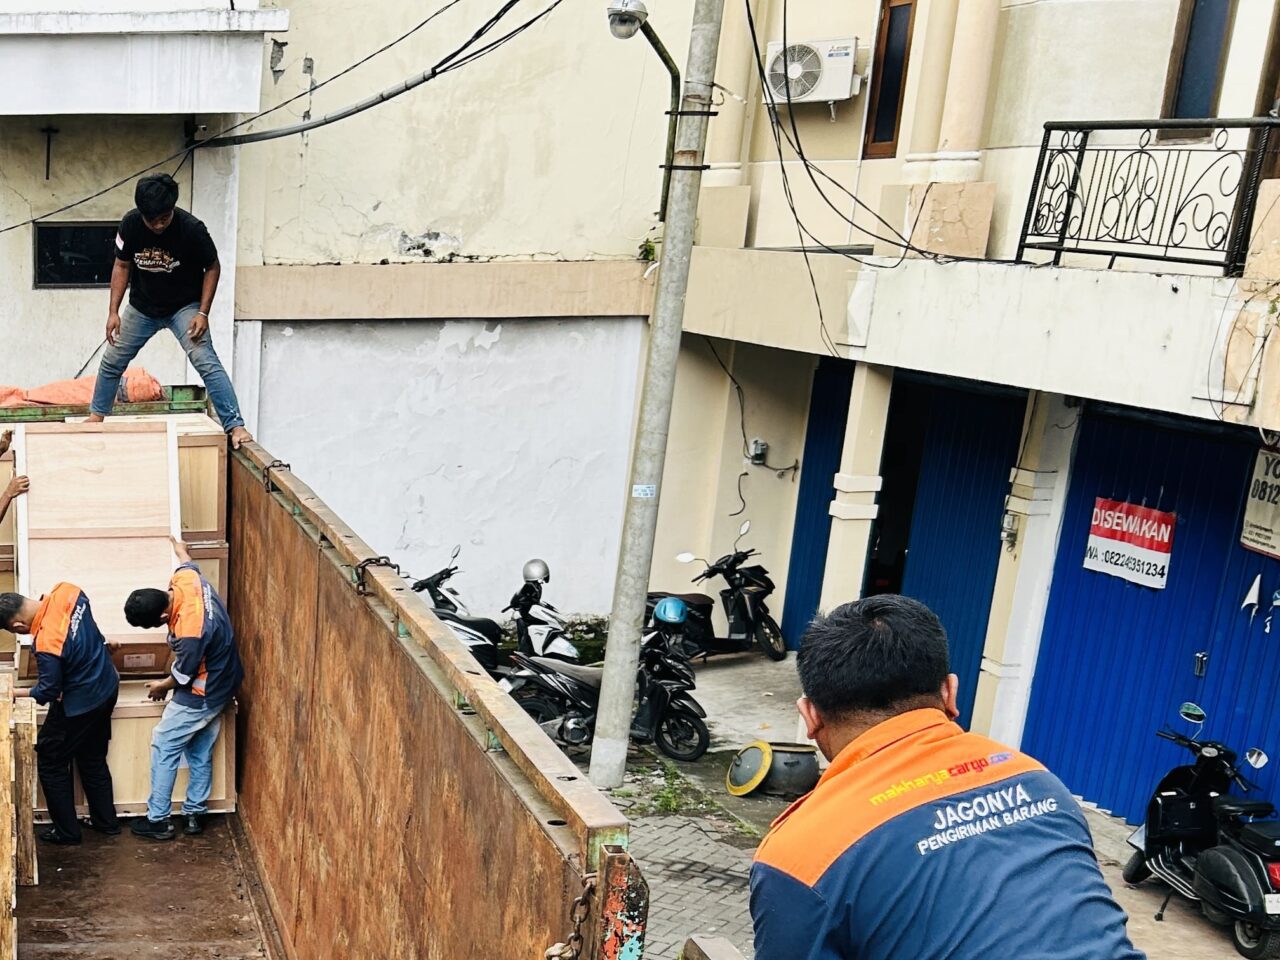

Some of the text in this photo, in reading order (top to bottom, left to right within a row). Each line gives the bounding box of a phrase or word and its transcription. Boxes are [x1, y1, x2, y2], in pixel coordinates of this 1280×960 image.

[1092, 508, 1171, 543] DISEWAKAN
[917, 797, 1058, 856] PENGIRIMAN BARANG
[933, 784, 1031, 830] JAGONYA
